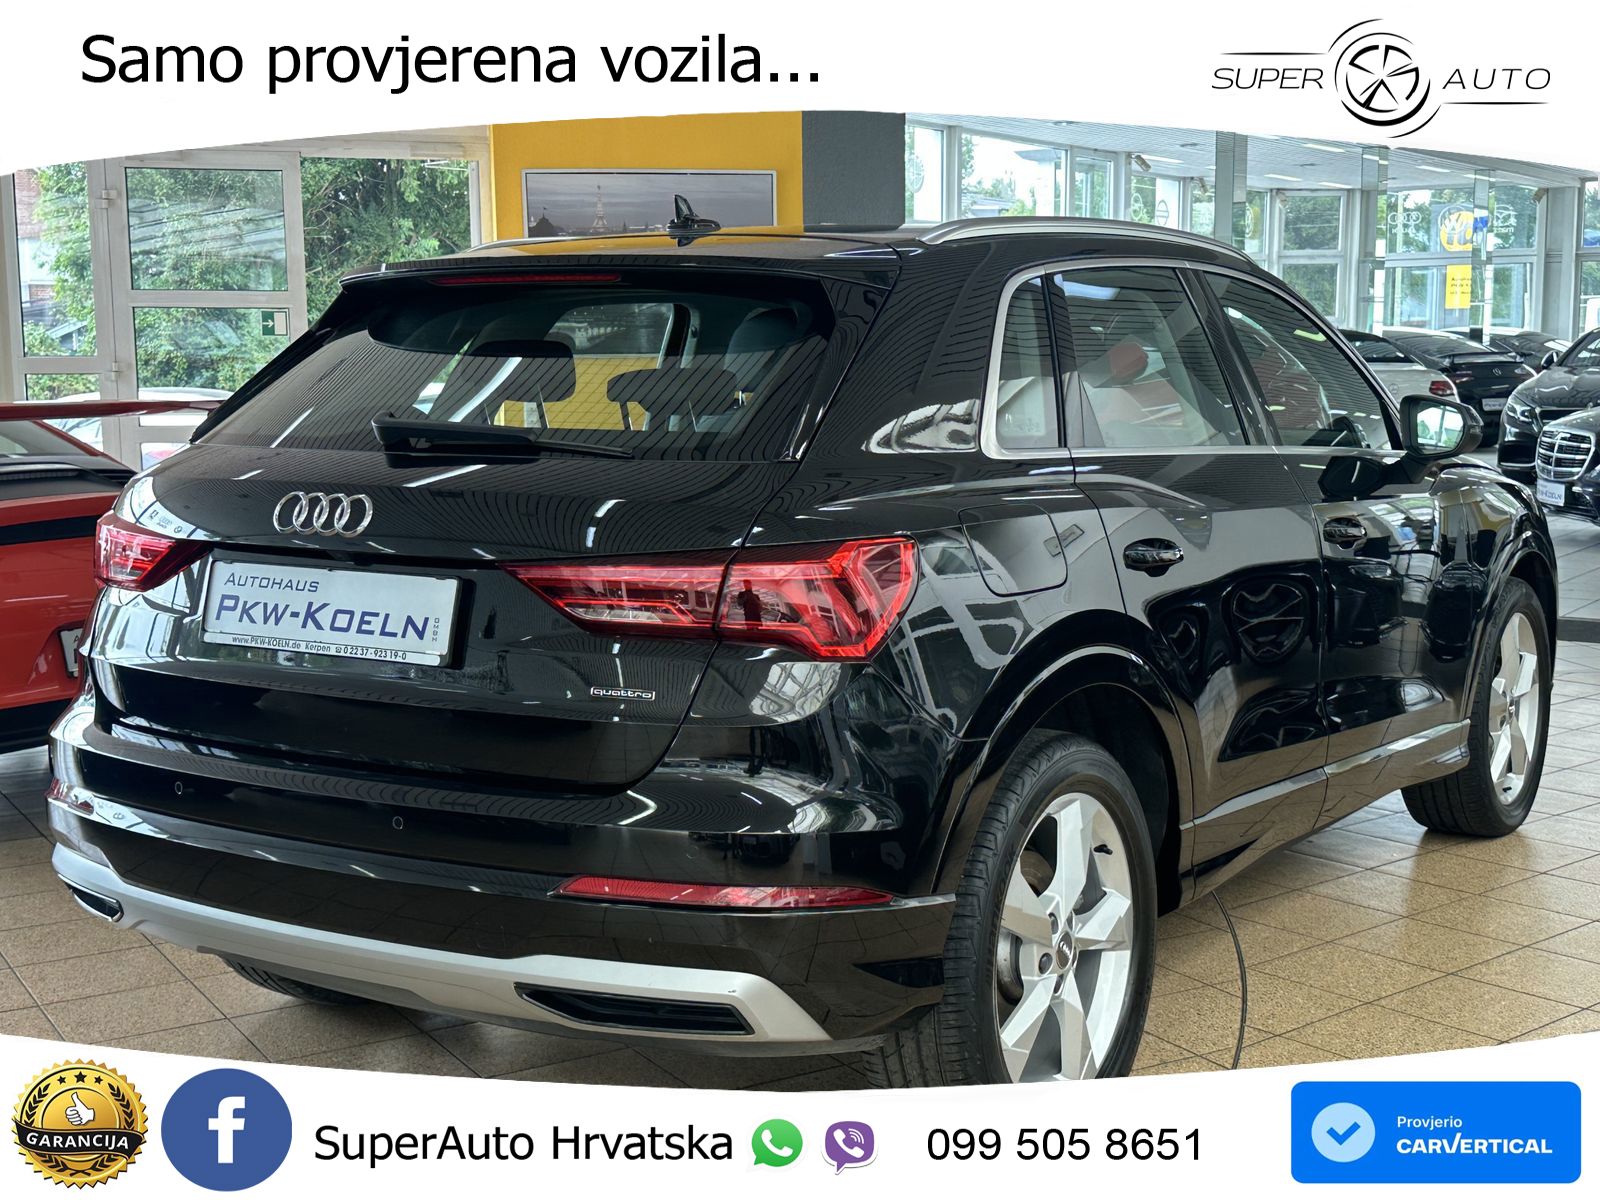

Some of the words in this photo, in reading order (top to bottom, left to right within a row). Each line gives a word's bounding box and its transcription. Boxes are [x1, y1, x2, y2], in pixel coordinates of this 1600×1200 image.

[224, 572, 320, 593] AUTOHAUS
[215, 594, 430, 641] PKW-KOELN
[304, 642, 331, 653] Kerpen
[593, 688, 652, 699] quattro
